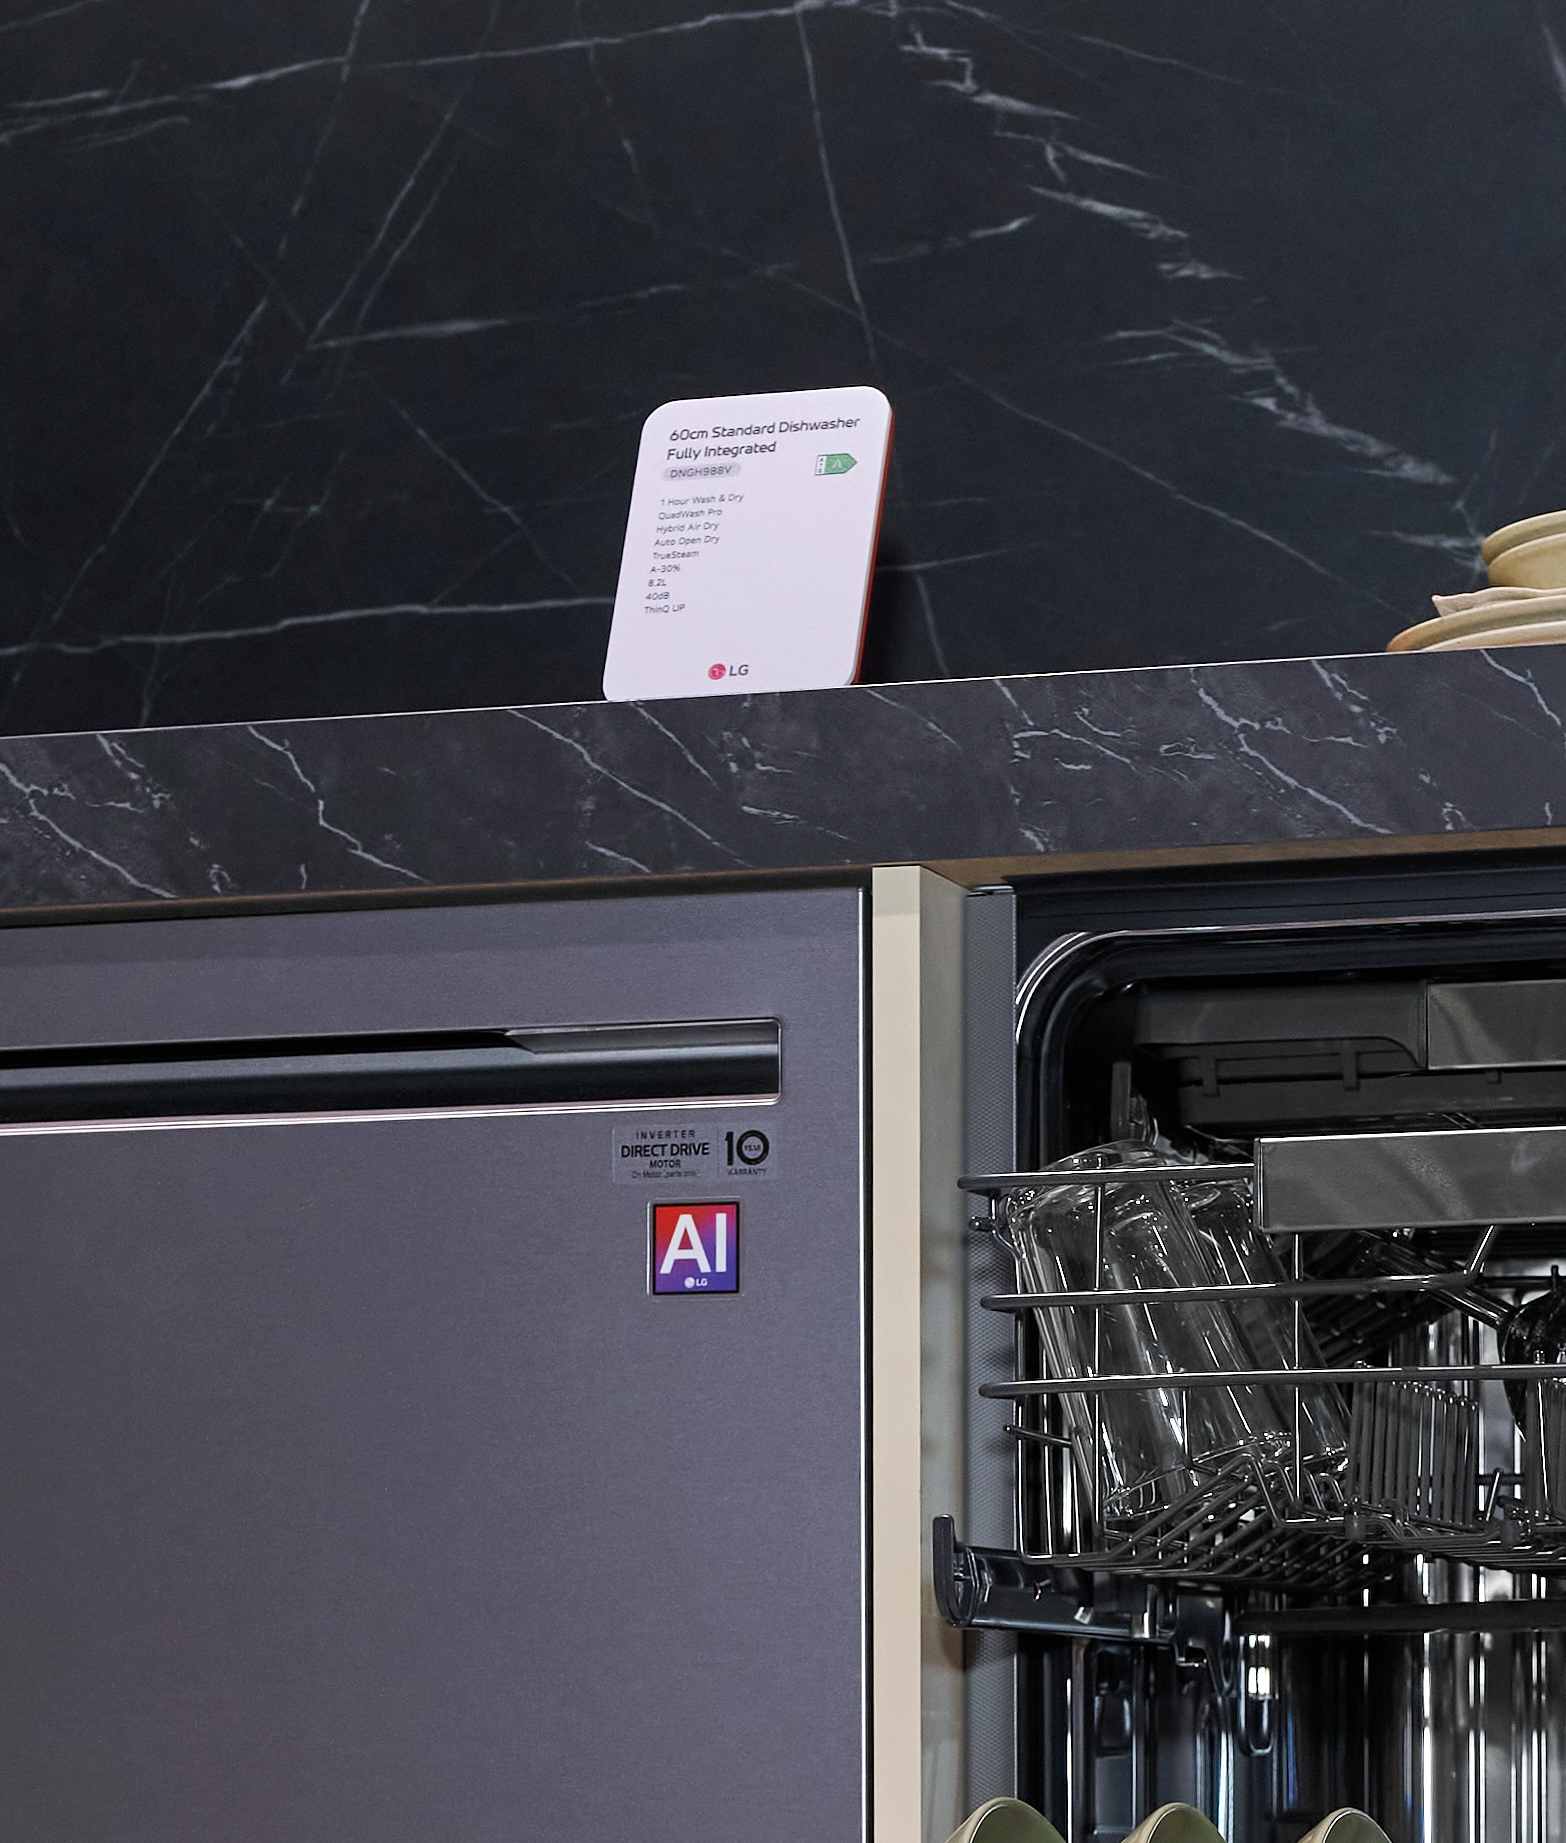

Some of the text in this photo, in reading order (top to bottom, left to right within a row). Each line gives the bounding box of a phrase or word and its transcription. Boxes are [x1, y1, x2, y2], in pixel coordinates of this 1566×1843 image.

[670, 417, 860, 441] 60cm Standard Dishwasher
[667, 441, 777, 461] Fully Integrated
[670, 465, 733, 478] DNGH988V
[668, 498, 689, 506] Hour
[693, 495, 716, 504] Wash
[718, 494, 726, 502] &
[728, 493, 744, 503] Dry
[658, 508, 723, 520] QuadWash Pro
[656, 522, 719, 534] Hybrid Air Dry
[678, 537, 701, 546] Open
[704, 535, 720, 544] Dry
[653, 551, 699, 560] TrueSteam
[649, 564, 681, 573] A-30%
[648, 578, 667, 587] 8.2L
[645, 591, 670, 600] 40dB
[644, 604, 686, 614] ThinQ UP
[729, 664, 749, 677] LG
[636, 1130, 695, 1140] INVERTER
[621, 1142, 710, 1158] DIRECT DRIVE
[725, 1129, 770, 1166] 10
[649, 1159, 681, 1169] MOTOR
[727, 1168, 767, 1177] WARRANTY
[659, 1213, 727, 1274] AI
[696, 1278, 708, 1287] LG
